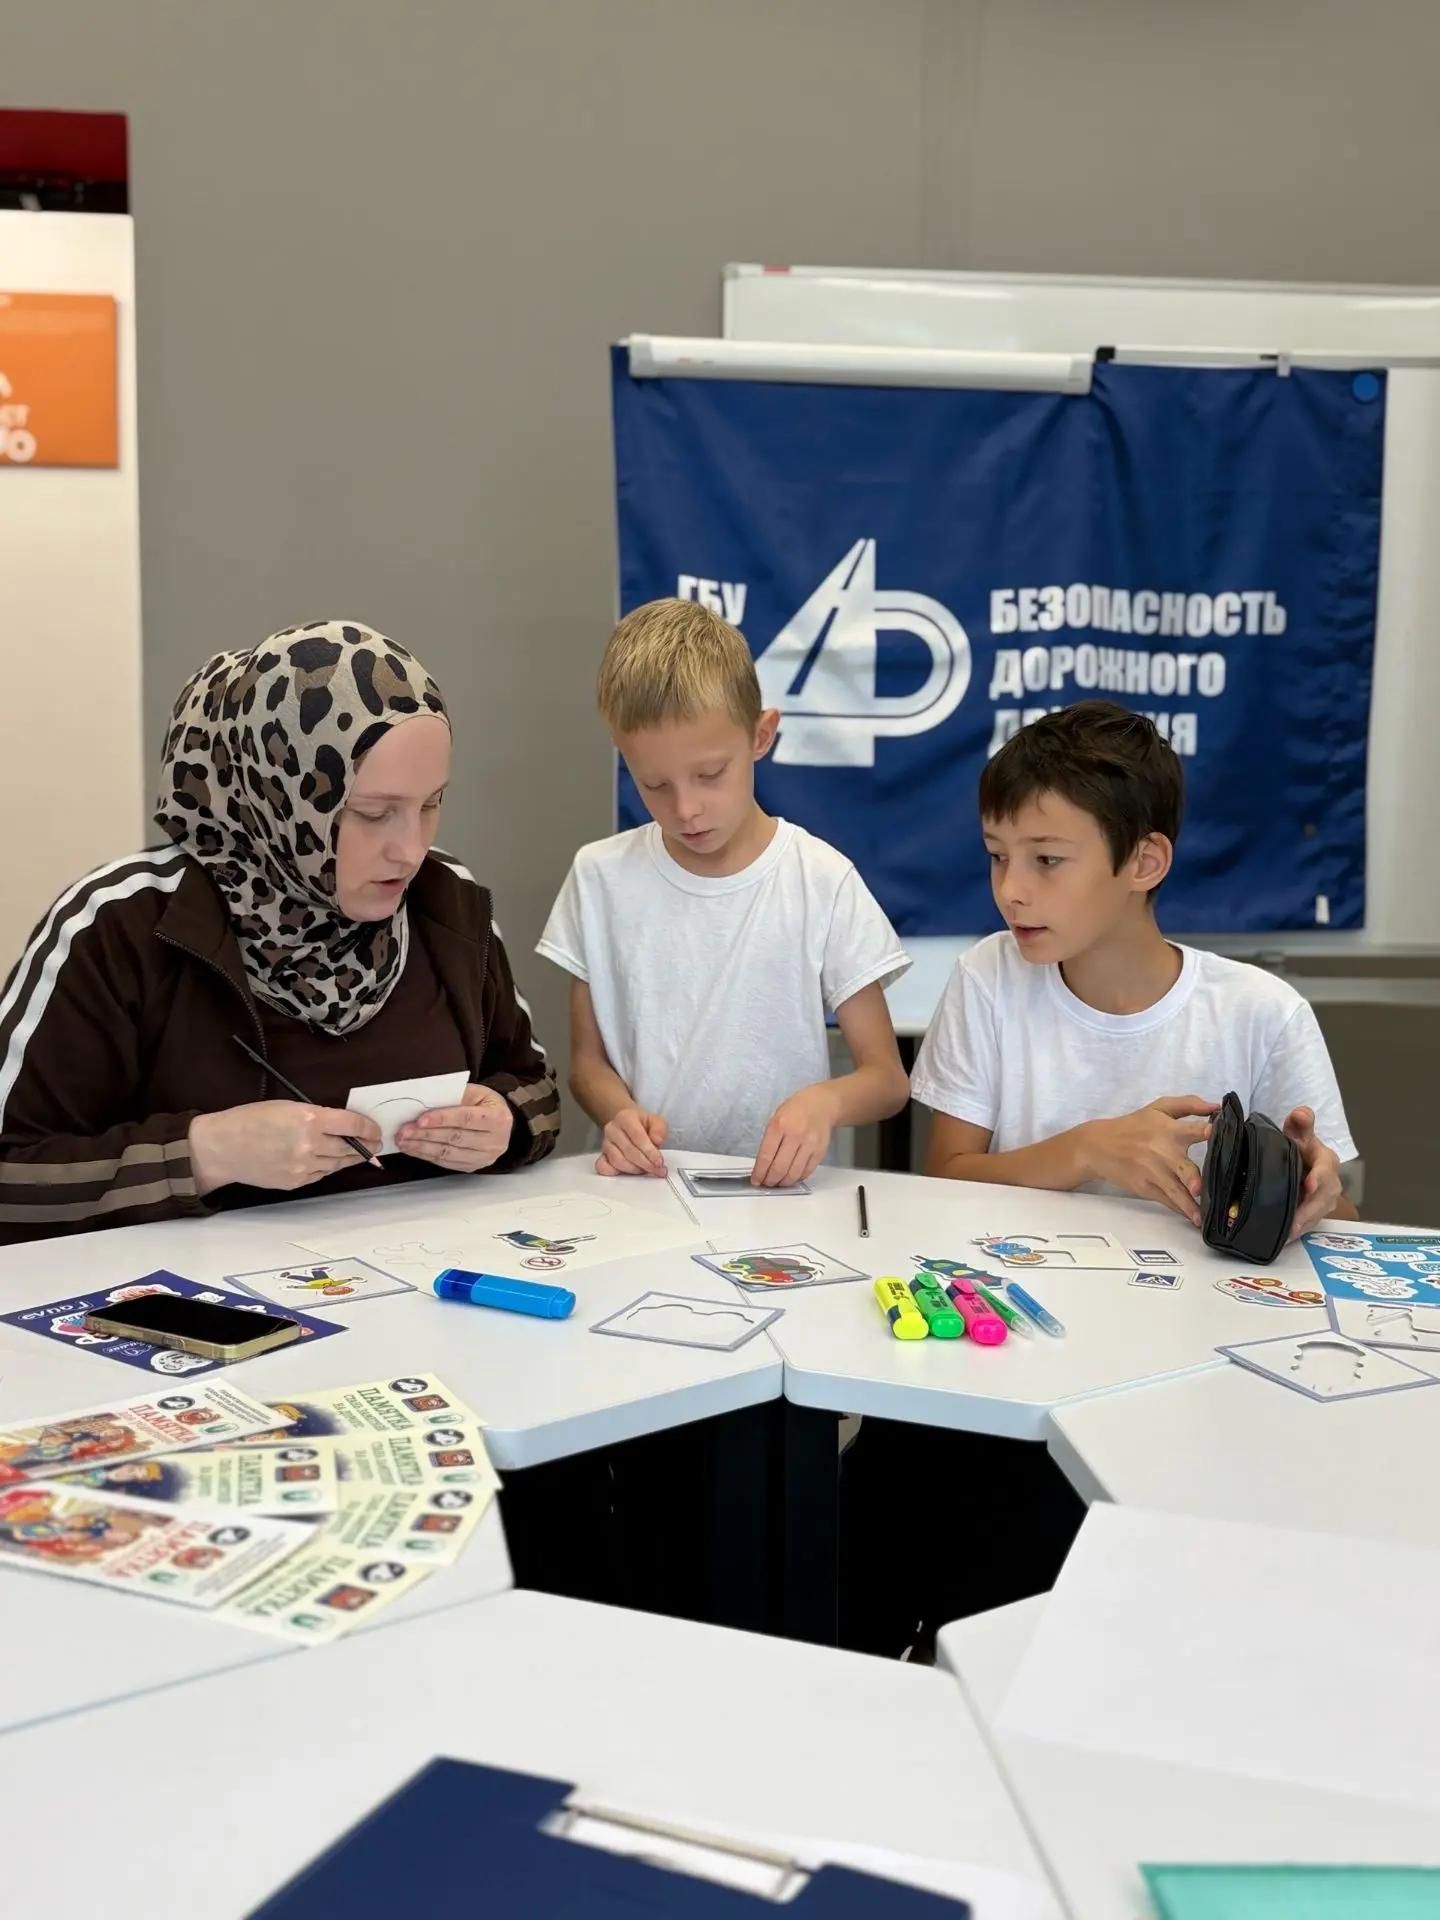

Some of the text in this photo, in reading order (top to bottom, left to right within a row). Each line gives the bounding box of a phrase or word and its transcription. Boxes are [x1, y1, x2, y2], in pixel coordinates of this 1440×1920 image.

[990, 583, 1287, 637] БЕЗОПАСНОСТЬ
[989, 644, 1226, 700] ДОРОЖНОГО
[127, 1404, 200, 1443] ПАМЯТКА
[357, 1387, 415, 1431] ПАМЯТКА
